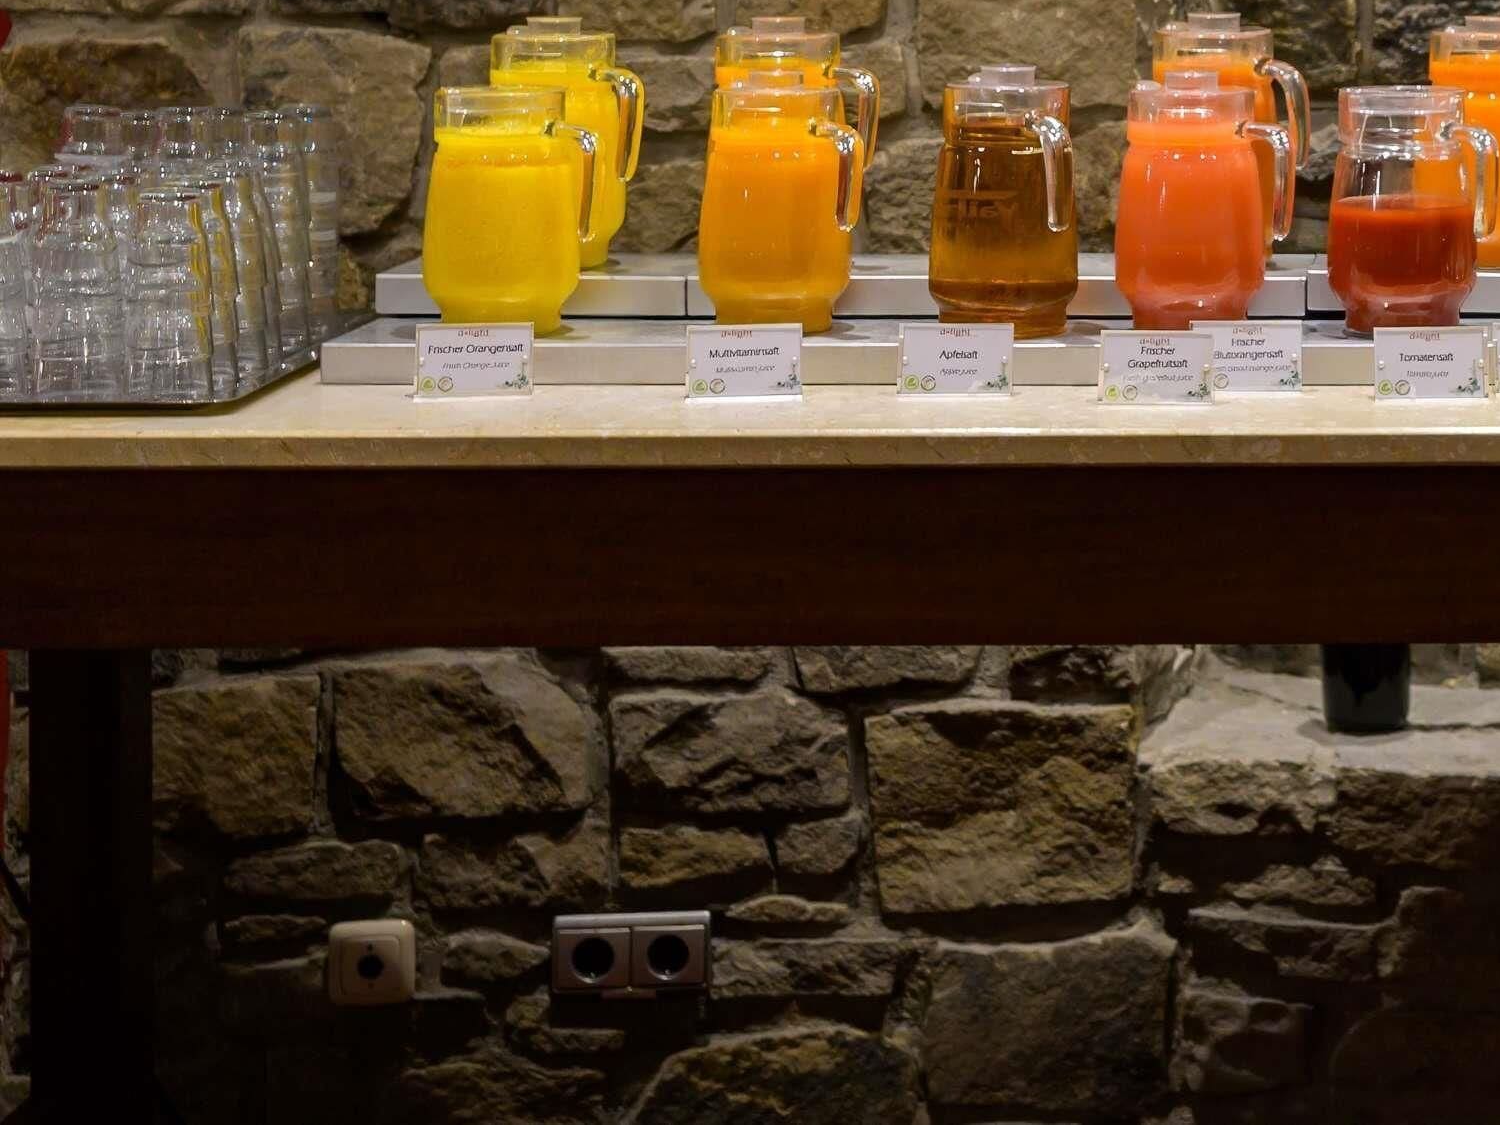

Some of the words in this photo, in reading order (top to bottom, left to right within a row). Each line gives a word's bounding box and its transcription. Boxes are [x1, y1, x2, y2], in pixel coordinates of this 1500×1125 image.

[1231, 338, 1266, 347] Frischer
[428, 345, 463, 355] Frischer
[466, 343, 524, 355] Orangensaft
[1141, 346, 1176, 355] Frischer
[939, 350, 978, 360] Apfelsaft
[1400, 353, 1454, 362] Tomatensaft
[1127, 359, 1188, 370] Grapefruitsaft
